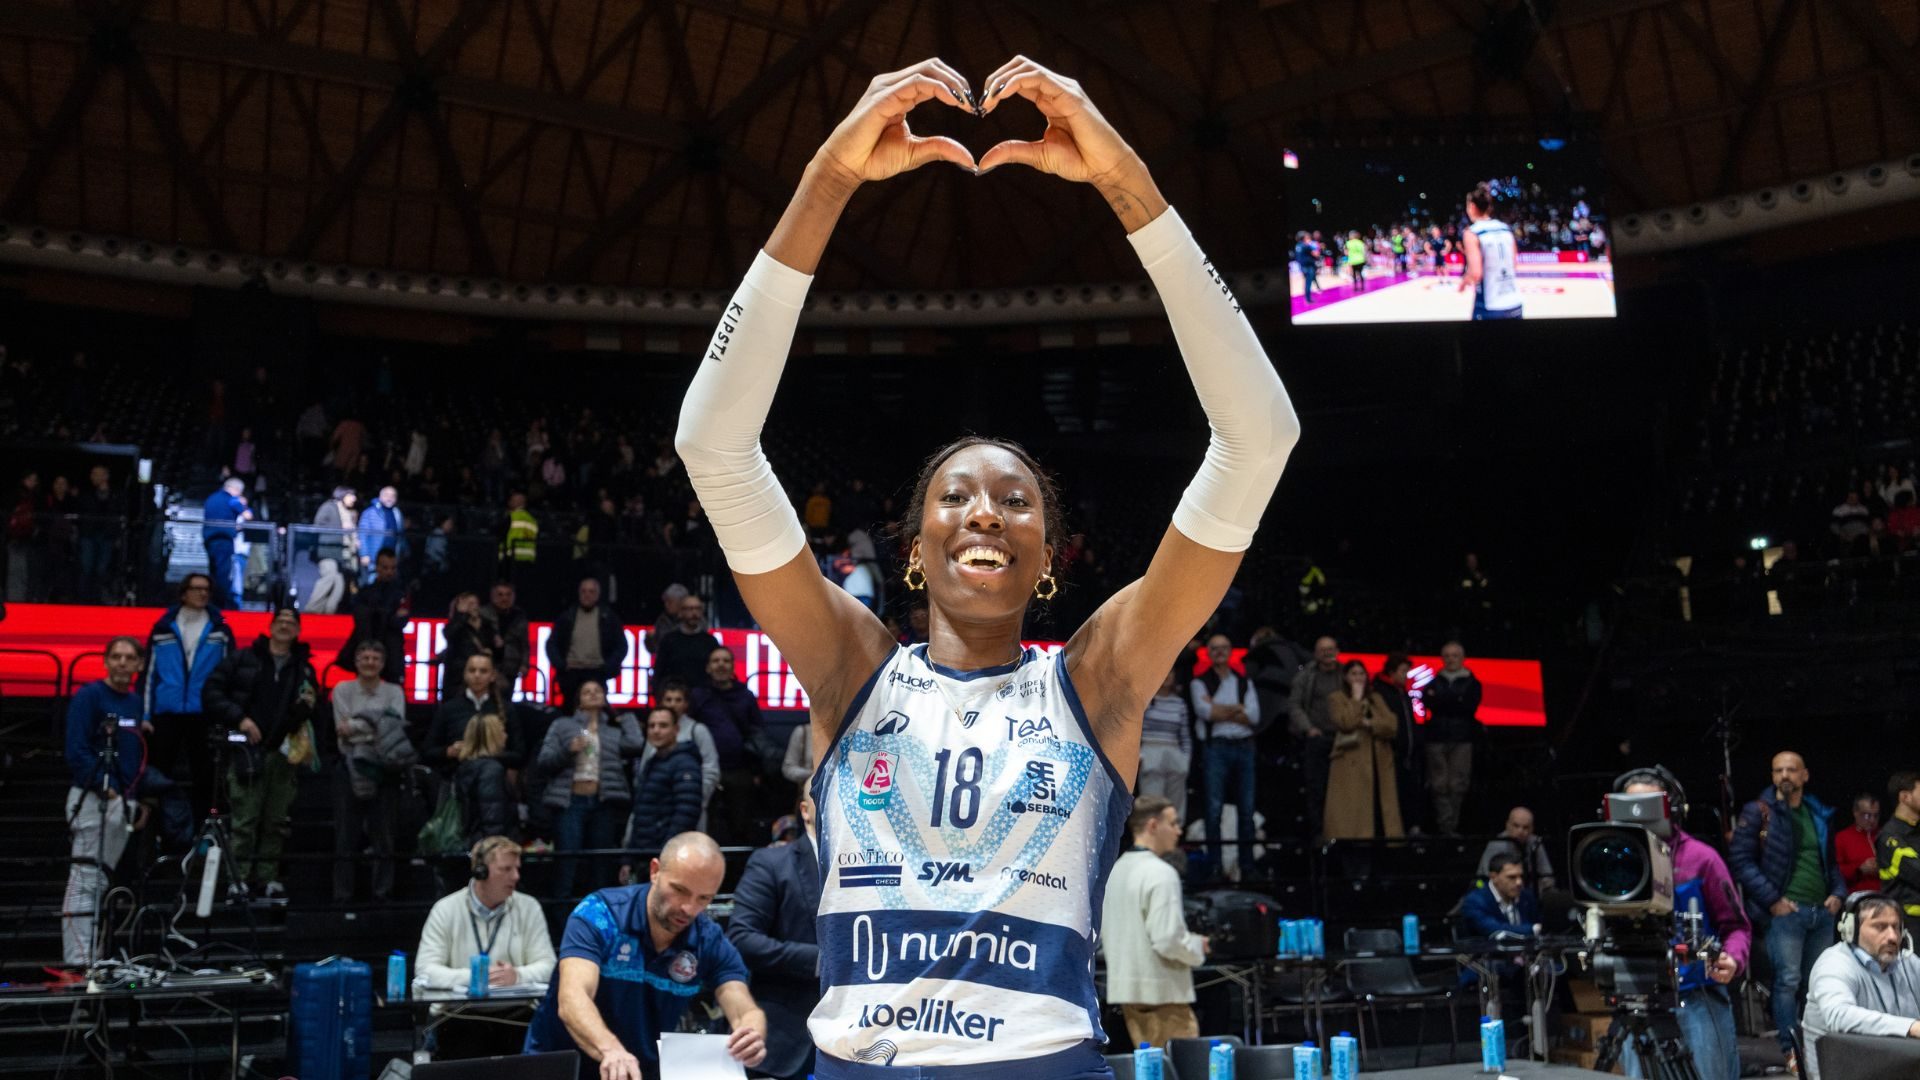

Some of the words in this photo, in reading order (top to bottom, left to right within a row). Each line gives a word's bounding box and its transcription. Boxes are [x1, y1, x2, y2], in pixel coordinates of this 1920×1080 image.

[709, 302, 744, 362] KIPSTA
[931, 747, 983, 829] 18
[1027, 803, 1071, 819] SEBACH
[838, 849, 904, 865] CONTECO
[917, 862, 974, 886] SYM
[900, 925, 1036, 970] numia
